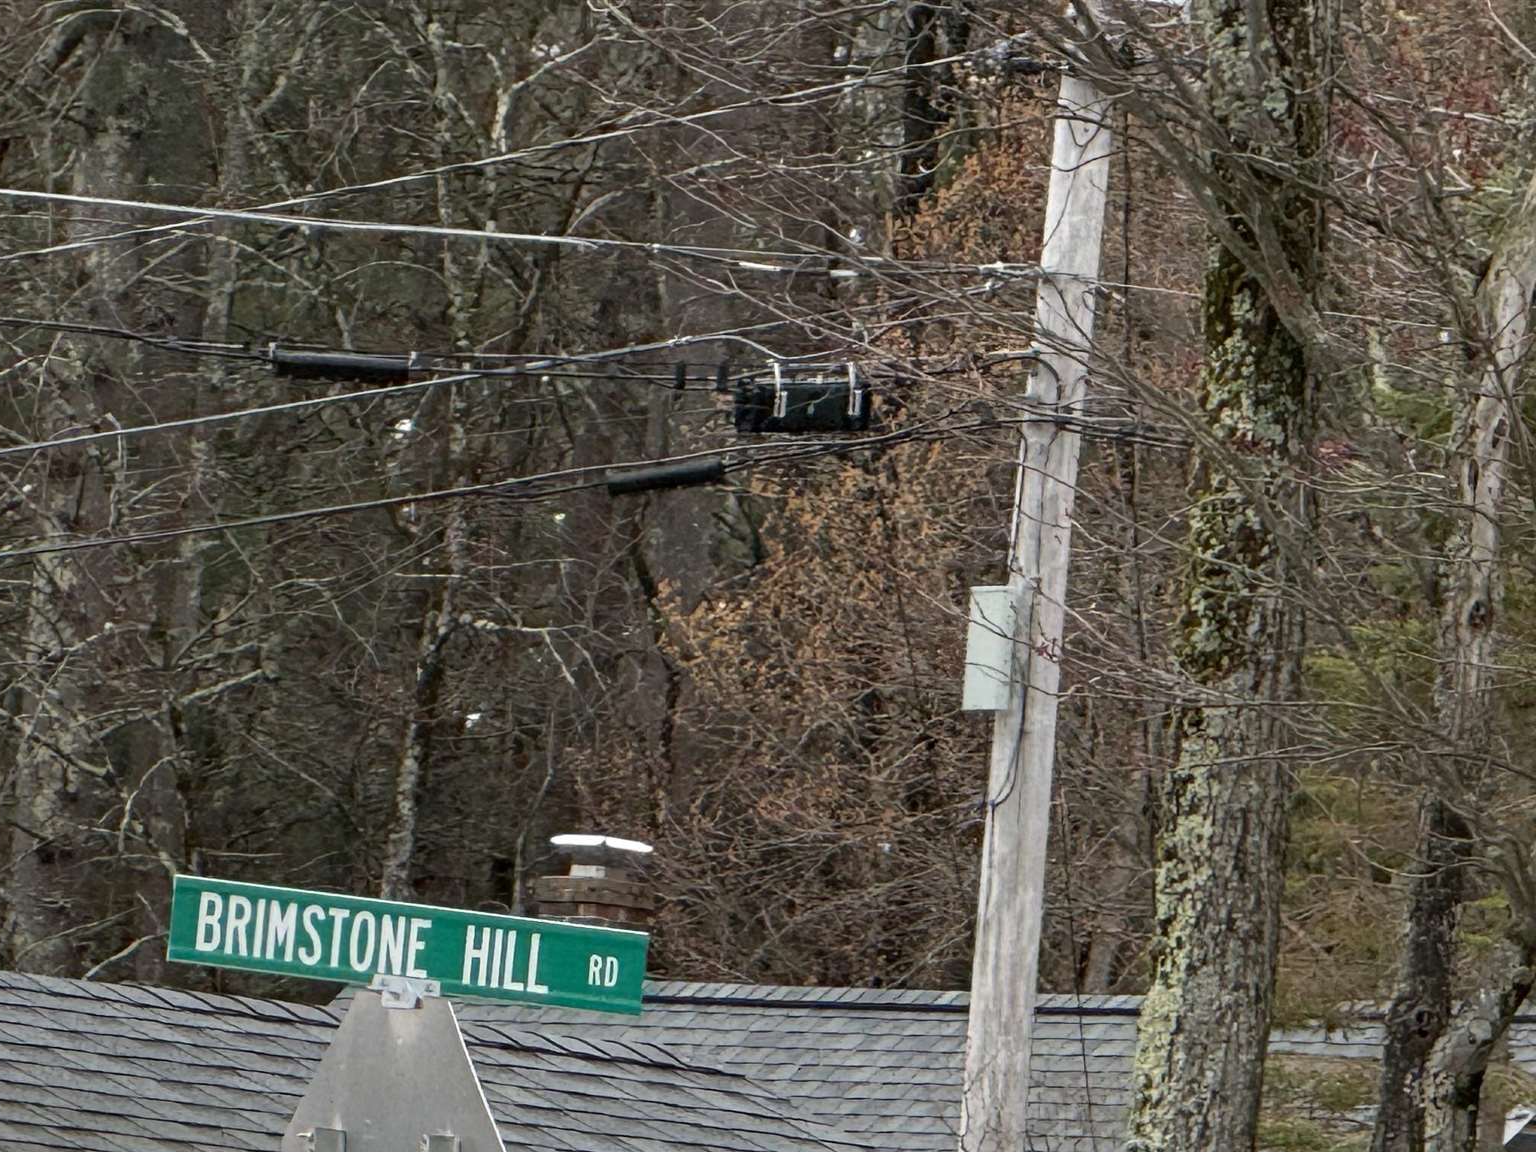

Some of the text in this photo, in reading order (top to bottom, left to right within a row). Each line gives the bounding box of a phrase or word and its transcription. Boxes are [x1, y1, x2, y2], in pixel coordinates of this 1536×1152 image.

[195, 891, 618, 994] BRIMSTONE HILL RD
